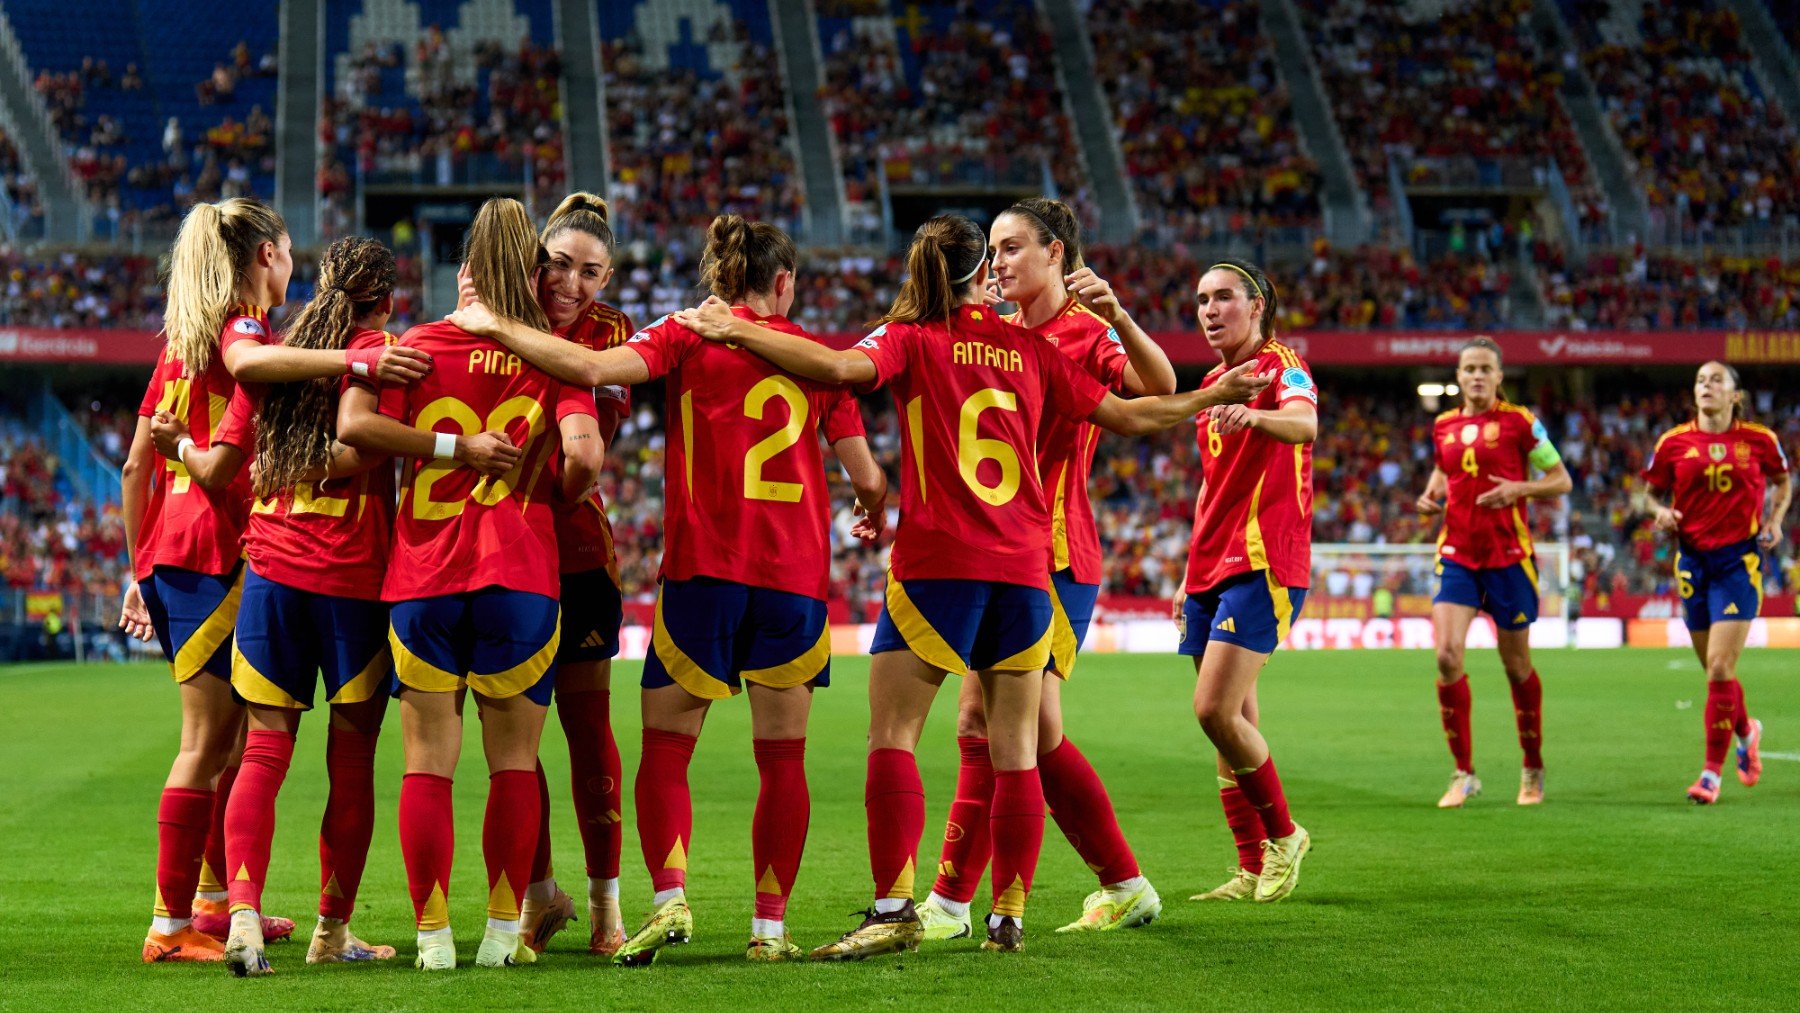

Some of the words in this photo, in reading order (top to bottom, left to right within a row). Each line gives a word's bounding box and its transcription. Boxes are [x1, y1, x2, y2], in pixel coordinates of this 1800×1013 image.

[468, 349, 523, 375] PINA
[953, 341, 1023, 373] AITANA
[743, 374, 809, 503] 2
[958, 387, 1021, 506] 6
[1461, 446, 1479, 478] 4
[1704, 462, 1734, 494] 16
